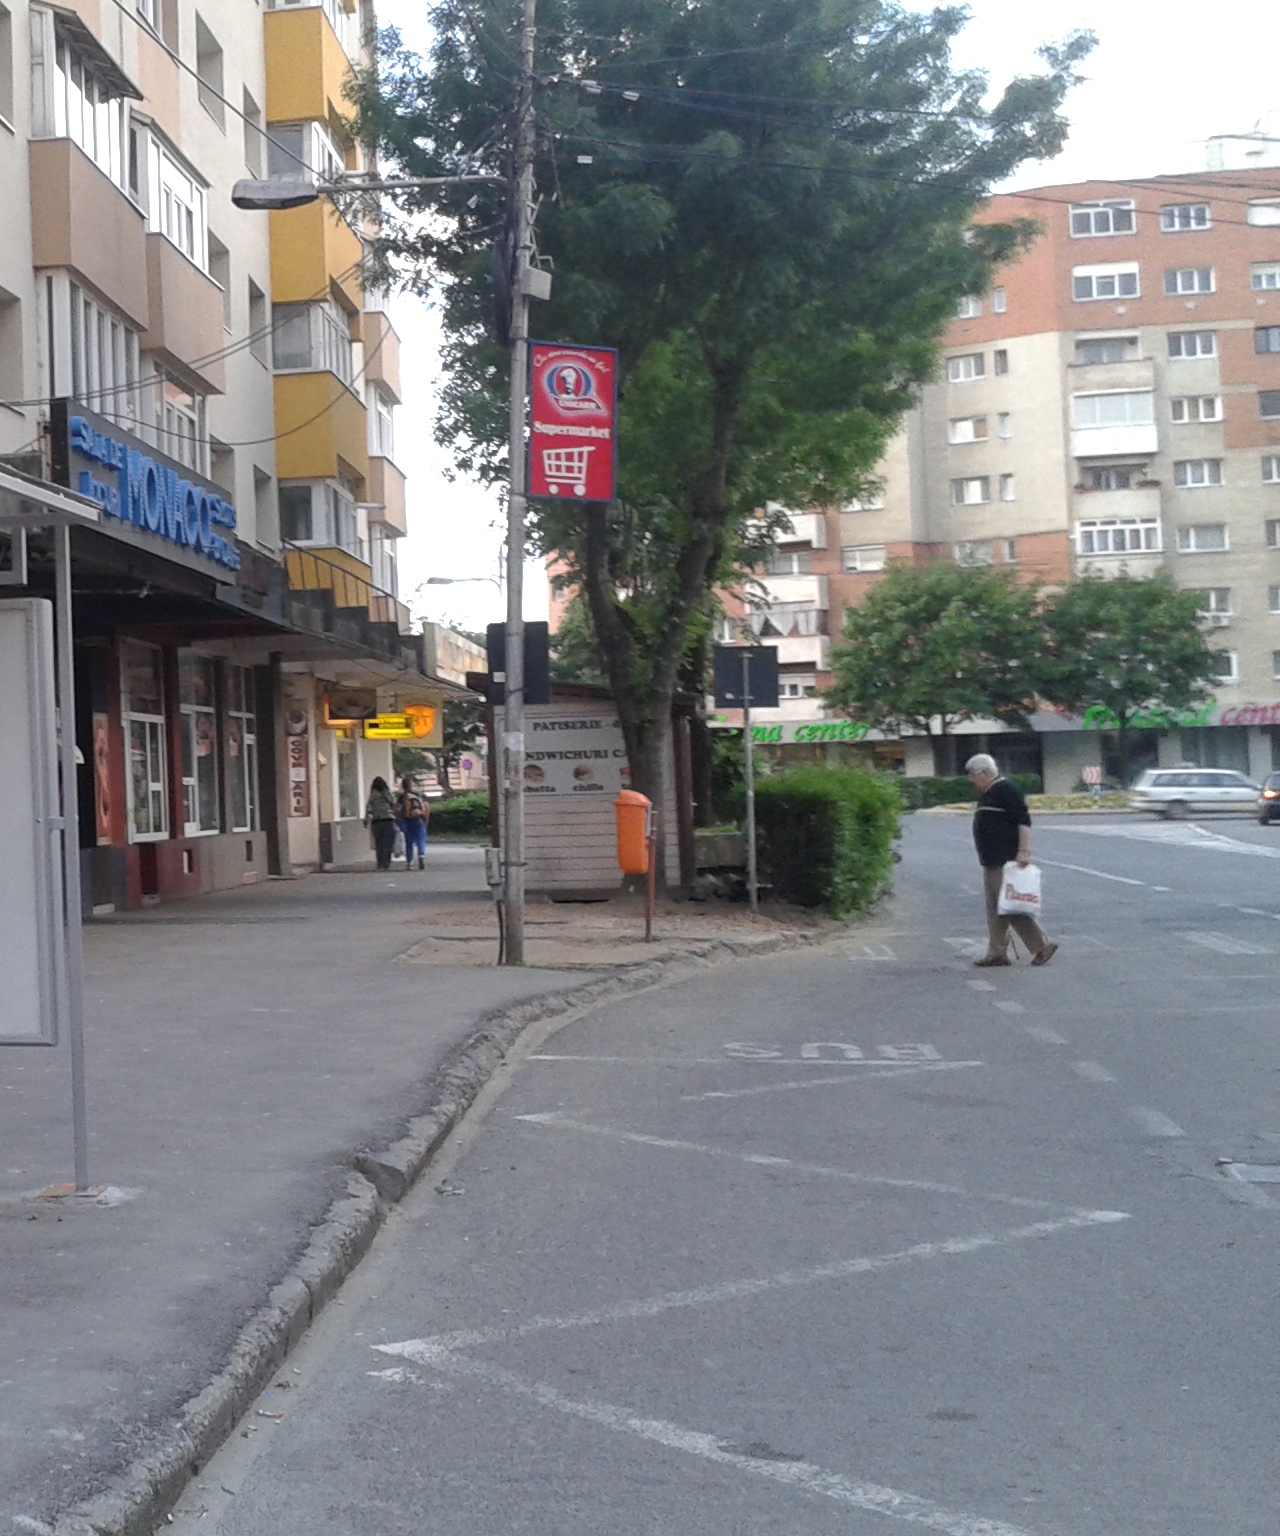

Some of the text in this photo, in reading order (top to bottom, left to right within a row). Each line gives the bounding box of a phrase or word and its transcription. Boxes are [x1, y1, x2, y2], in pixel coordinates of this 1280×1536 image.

[118, 444, 213, 554] MONACO
[532, 719, 603, 732] PATISERIE
[792, 719, 872, 742] center
[523, 749, 609, 762] NDWICHURI
